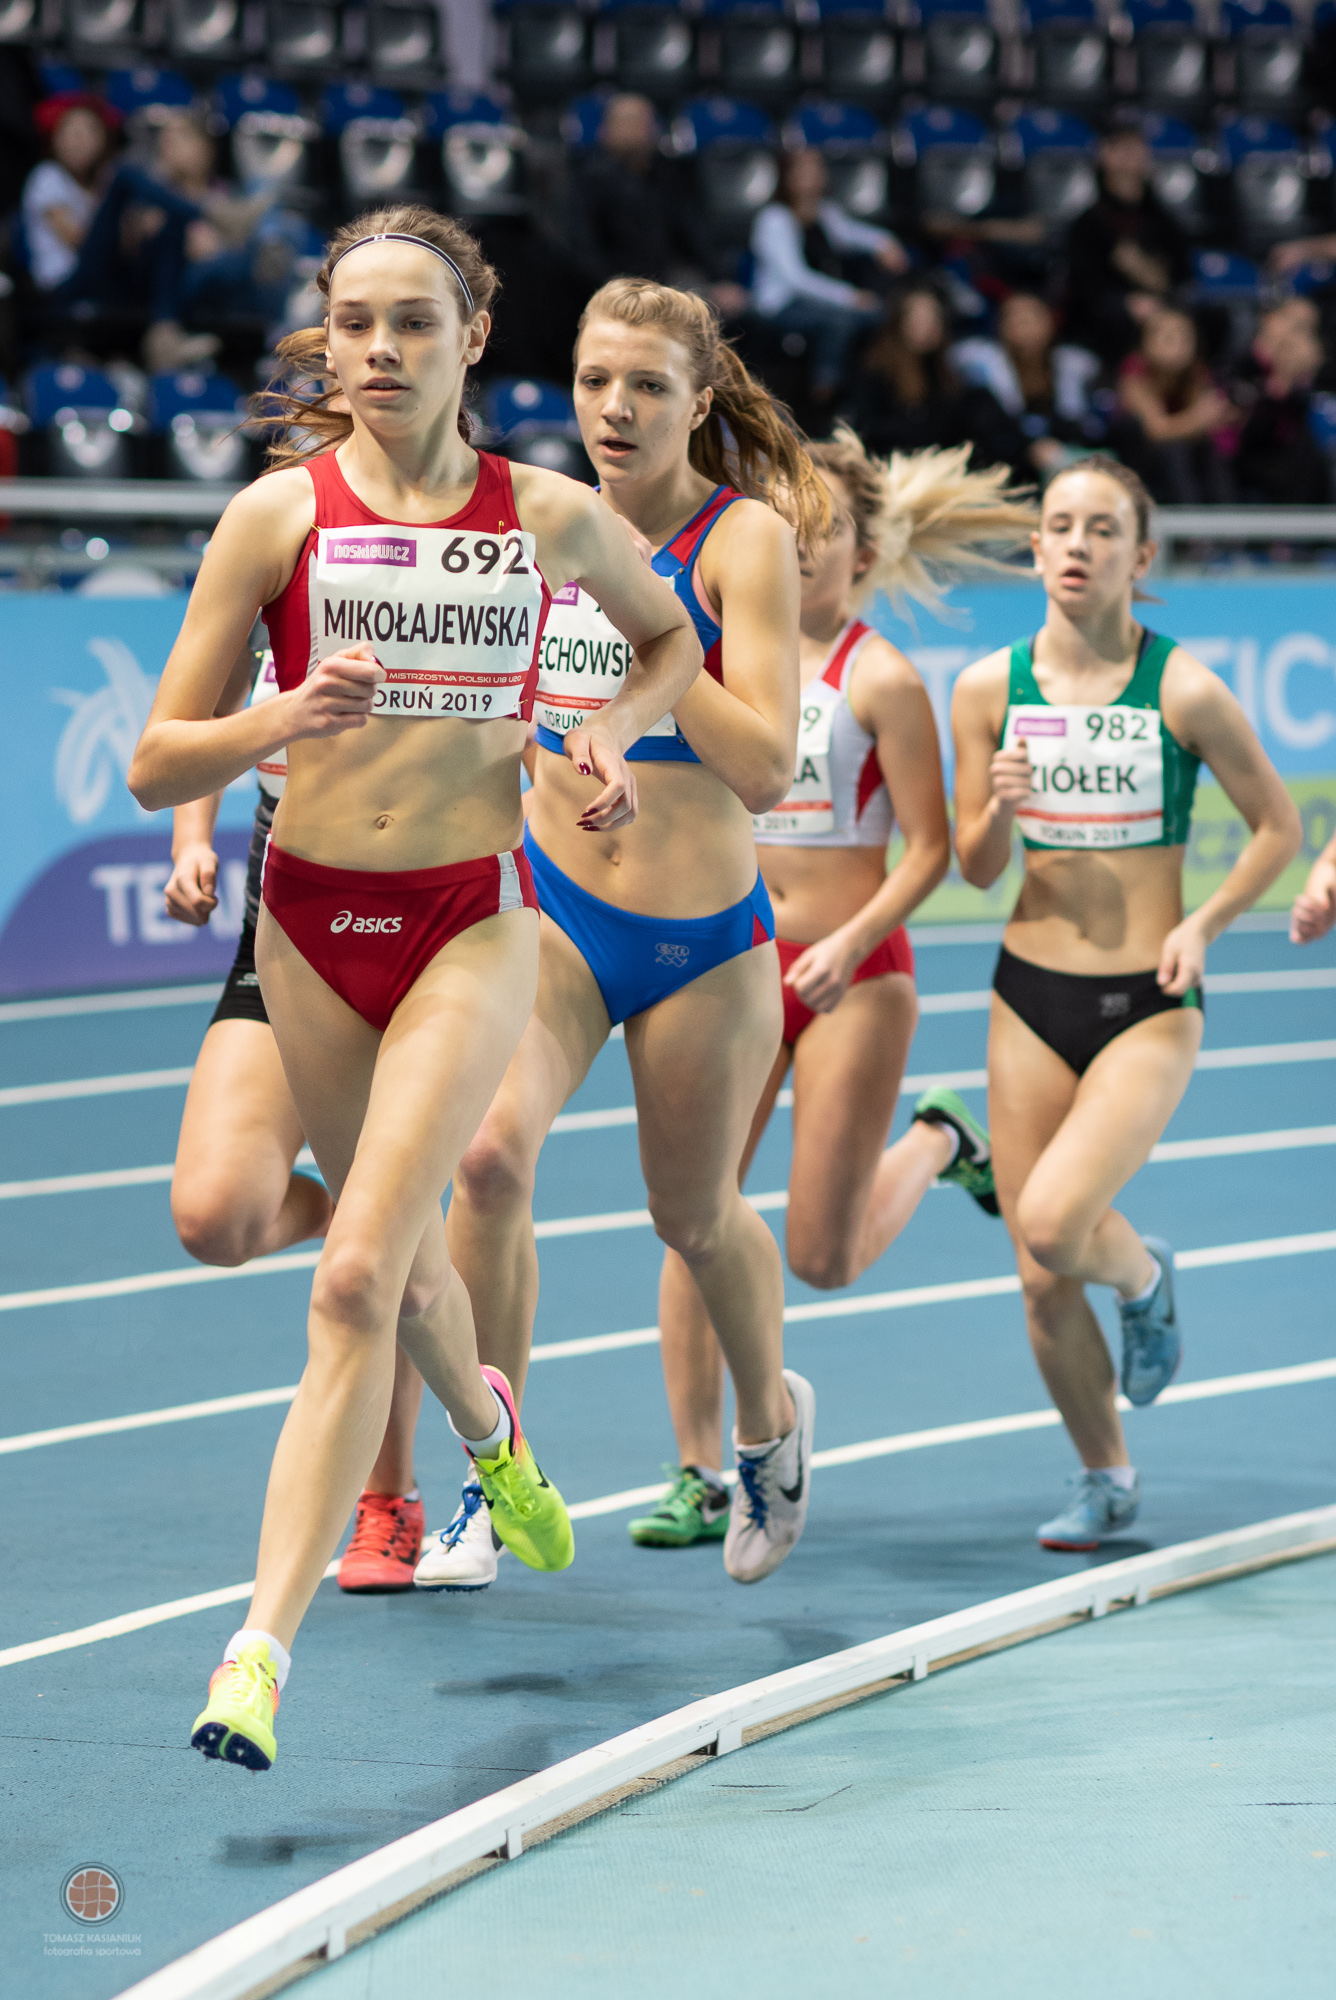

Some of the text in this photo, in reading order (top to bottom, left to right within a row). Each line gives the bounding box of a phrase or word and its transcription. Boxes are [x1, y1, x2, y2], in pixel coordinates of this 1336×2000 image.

[441, 536, 530, 575] 692
[324, 598, 530, 647] MIKOŁAJEWSKA
[389, 672, 457, 682] MISTRZOSTWA
[458, 675, 491, 683] POLSKI
[493, 676, 507, 684] U18
[374, 686, 492, 712] ORUŃ 2019
[1086, 713, 1149, 741] 982
[352, 916, 402, 933] asics
